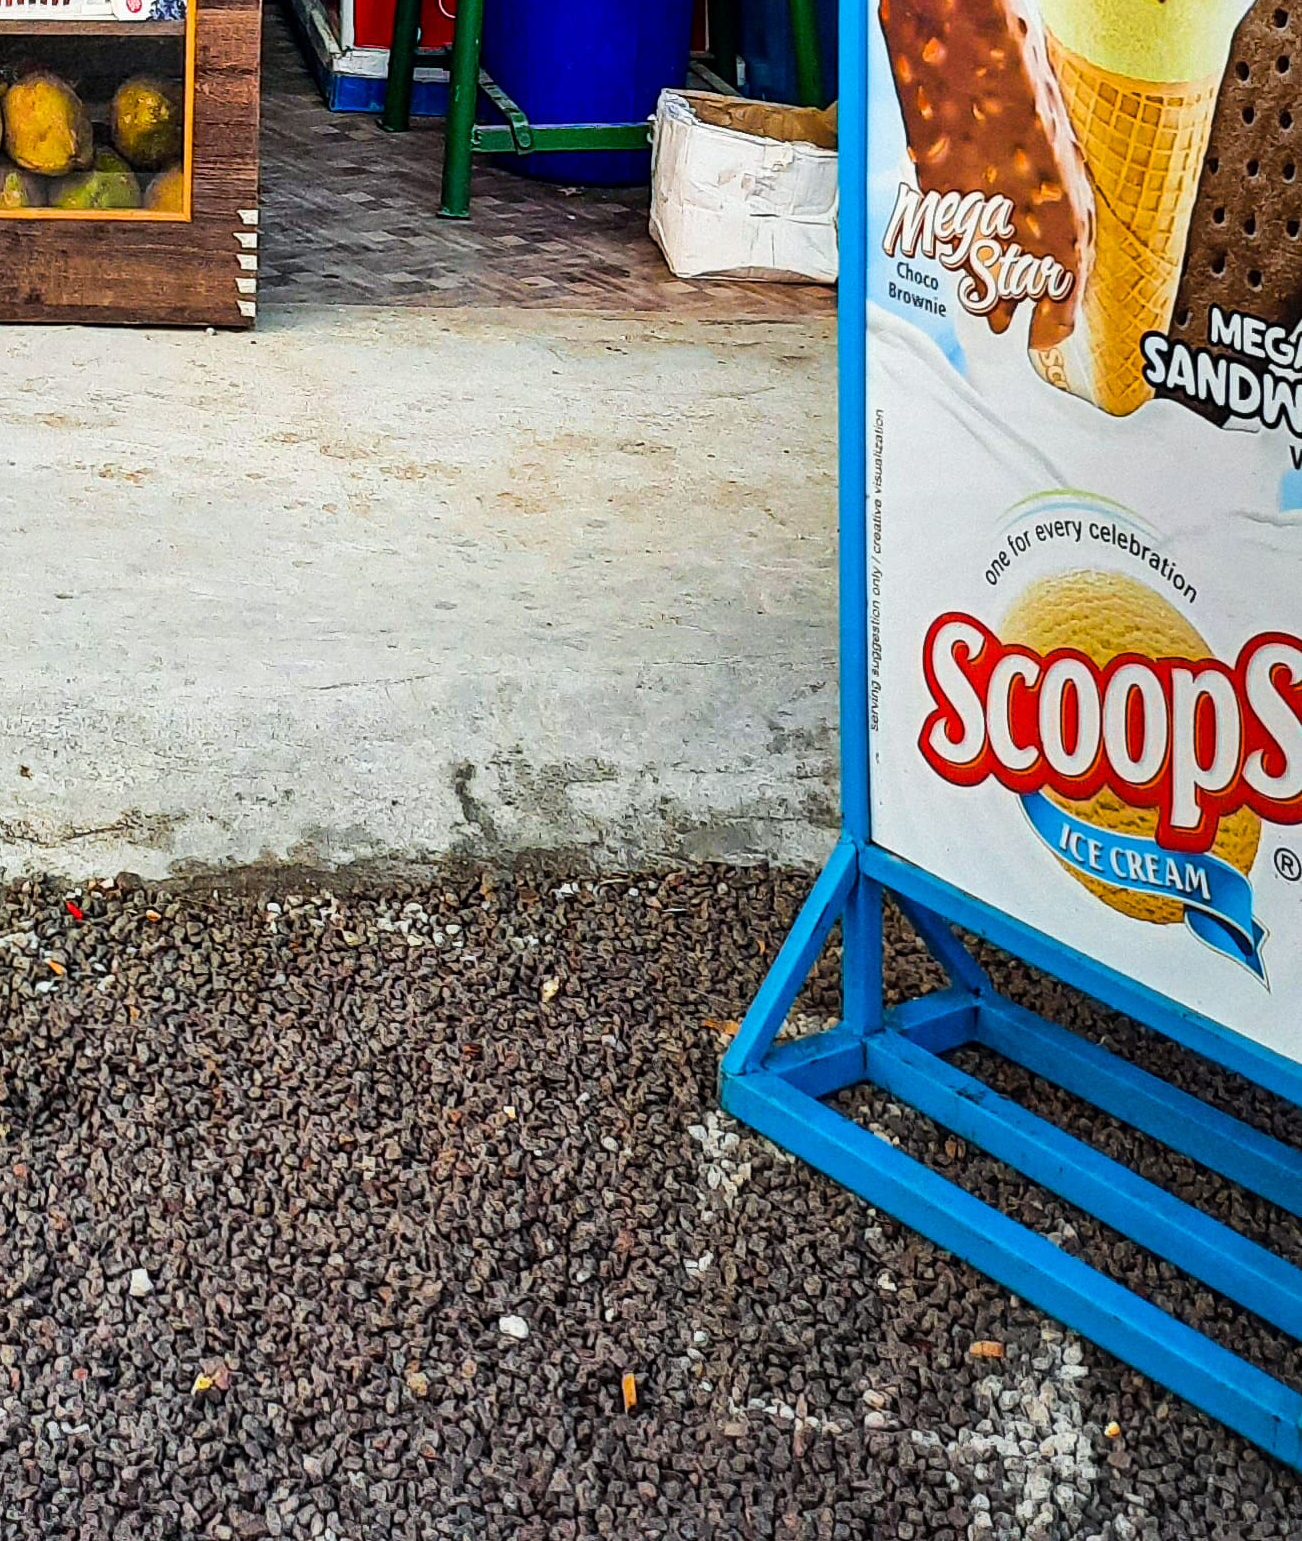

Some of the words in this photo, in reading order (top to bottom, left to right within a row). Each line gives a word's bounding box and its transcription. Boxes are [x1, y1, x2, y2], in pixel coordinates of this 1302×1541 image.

[882, 182, 1017, 271] Mega
[888, 282, 947, 317] Brownie
[896, 261, 939, 291] Choco
[958, 238, 1074, 317] Star
[985, 549, 1011, 586] one
[1007, 530, 1032, 557] for
[1035, 519, 1083, 543] every
[1089, 522, 1198, 604] celebration
[1059, 822, 1105, 872] ICE
[1109, 846, 1212, 901] CREAM
